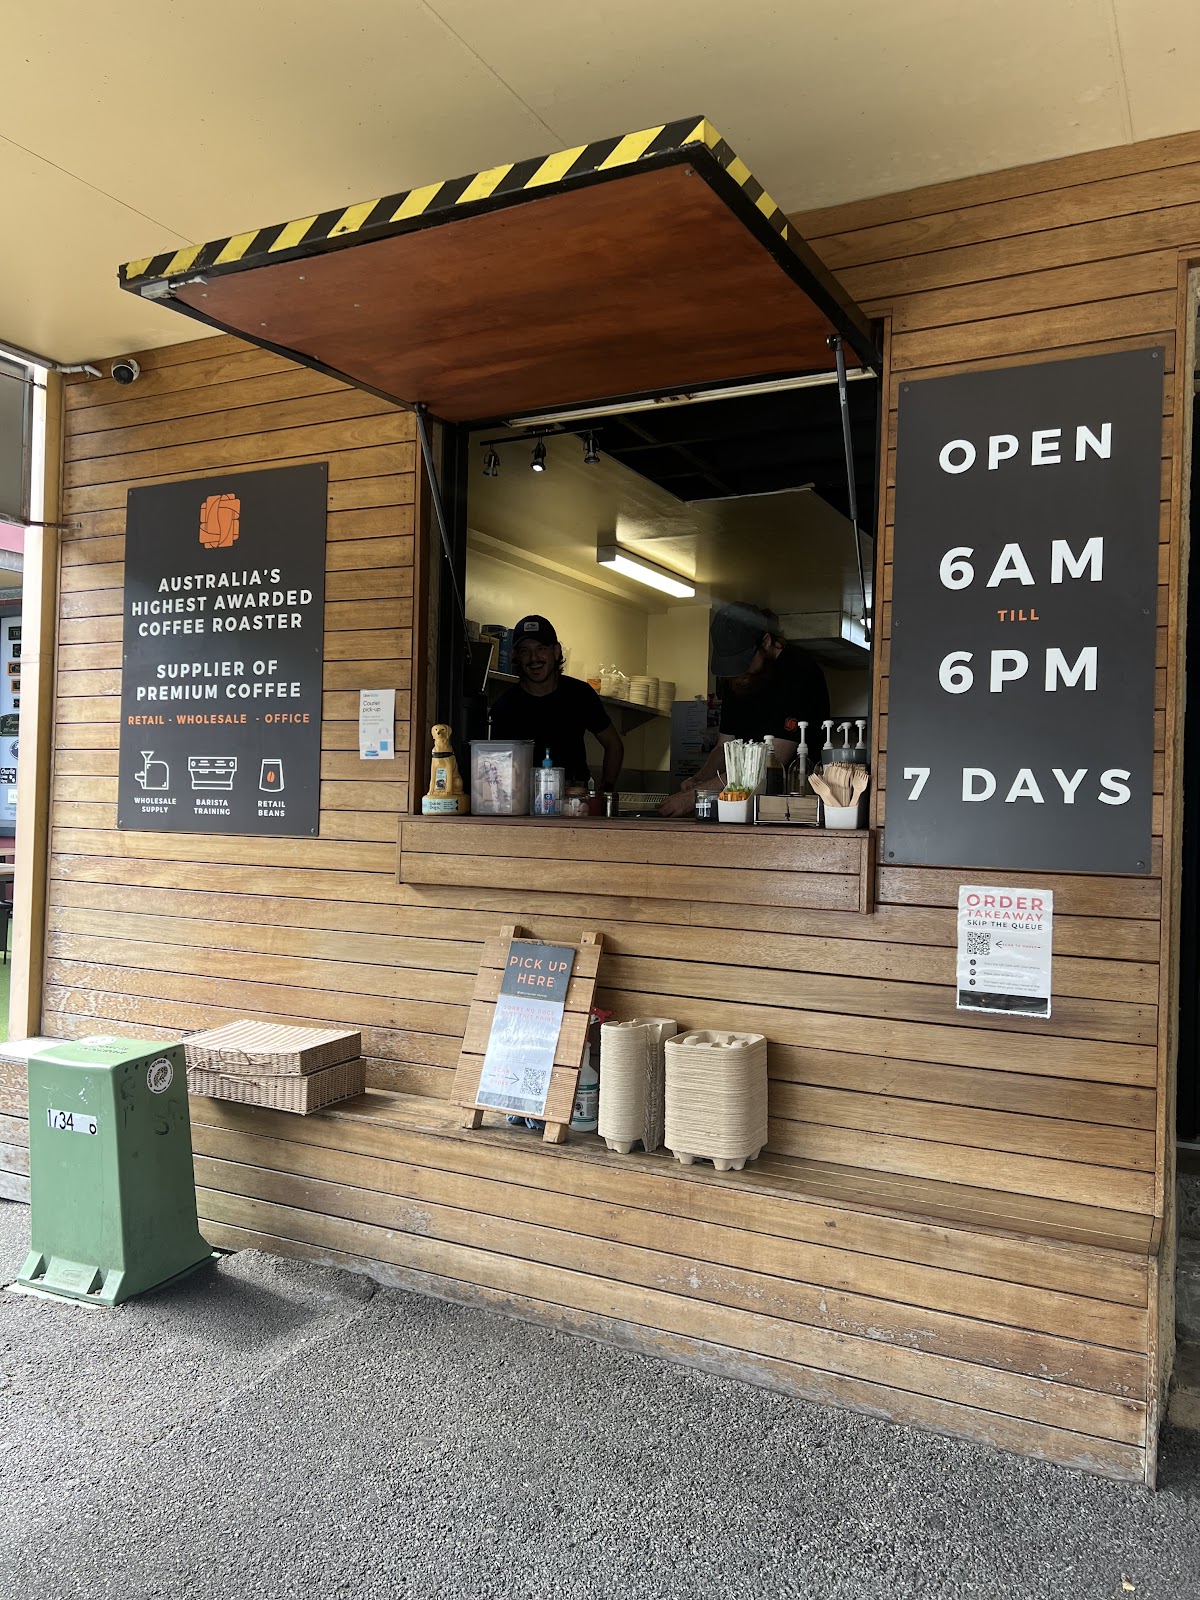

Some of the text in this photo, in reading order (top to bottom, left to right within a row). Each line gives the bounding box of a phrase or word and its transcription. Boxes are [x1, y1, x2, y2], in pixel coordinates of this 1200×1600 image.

[938, 422, 1113, 476] OPEN
[938, 536, 1105, 591] 6AM
[158, 568, 282, 593] AUSTRALIA'S
[131, 590, 313, 616] HIGHEST AWARDED
[997, 609, 1040, 622] TILL
[138, 612, 303, 637] COFFEE ROASTER
[156, 659, 278, 680] SUPPLIER OF
[938, 646, 1098, 694] 6PM
[136, 682, 302, 701] PREMIUM COFFEE
[128, 714, 165, 725] RETAIL
[176, 714, 247, 725] WHOLESALE
[264, 713, 310, 724] OFFICE
[903, 767, 1132, 806] 7 DAYS
[134, 796, 177, 805] WHOLESALE
[195, 798, 228, 807] BARISTA
[258, 800, 286, 808] RETAIL
[141, 805, 168, 814] SUPPLY
[194, 807, 231, 816] TRAINING
[258, 808, 285, 817] BEANS
[966, 894, 1043, 911] ORDER
[967, 909, 1044, 922] TAKEAWAY
[509, 956, 568, 972] PICK UP
[517, 974, 555, 988] HERE
[503, 1004, 525, 1012] SORRY
